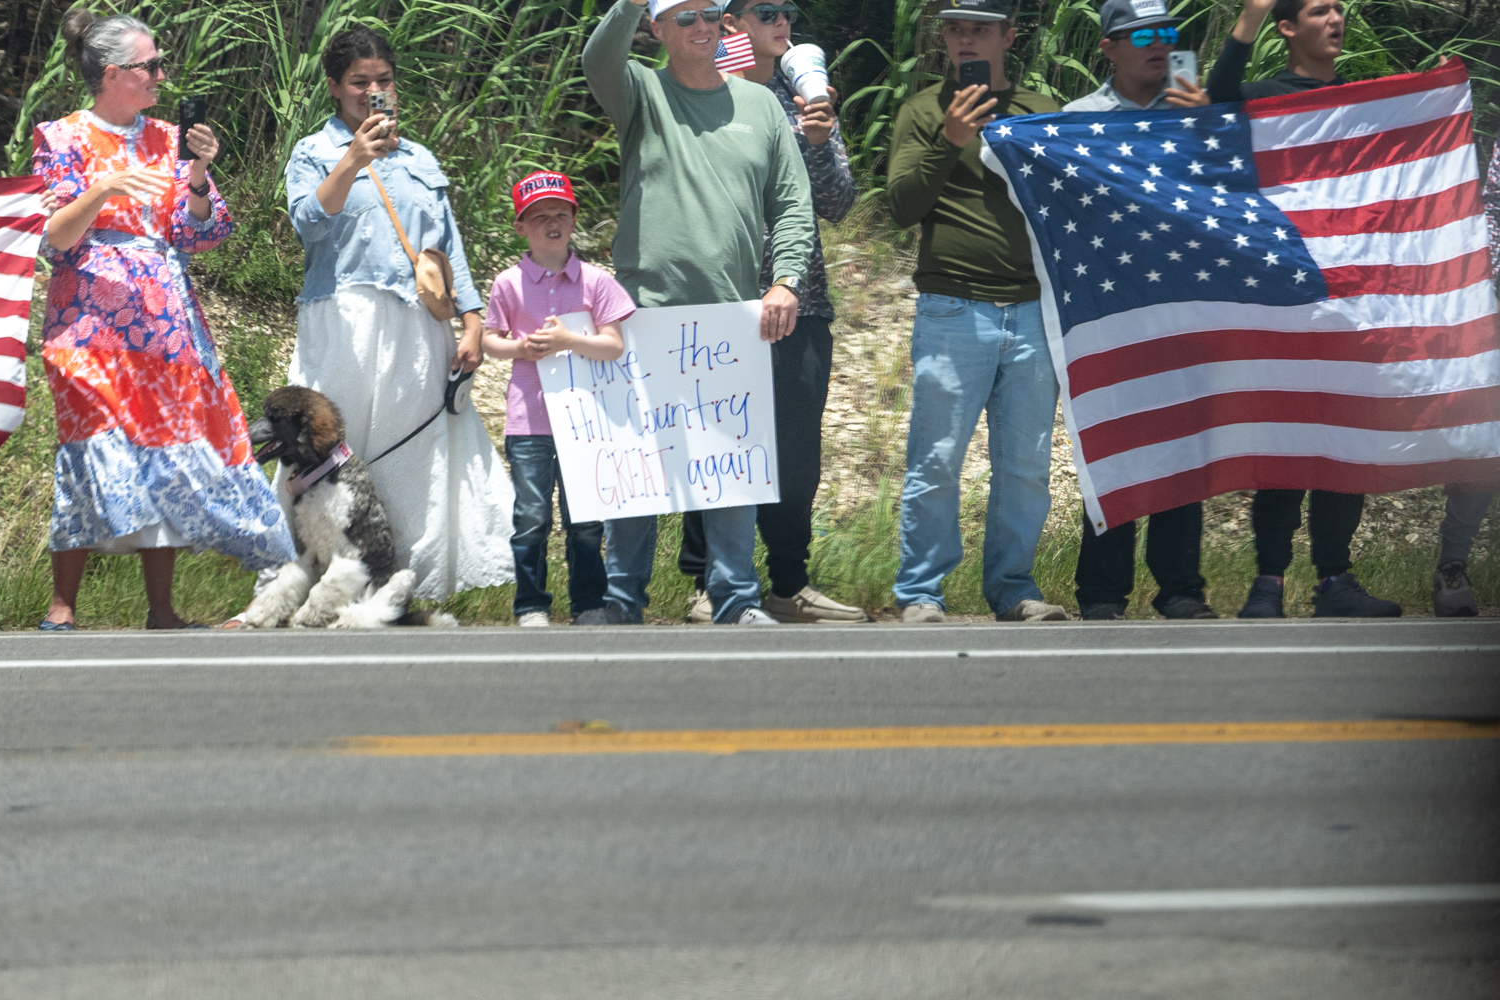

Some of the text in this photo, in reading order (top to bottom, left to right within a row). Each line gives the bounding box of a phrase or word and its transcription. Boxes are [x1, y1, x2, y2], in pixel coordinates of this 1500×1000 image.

[518, 178, 566, 197] TRUMP
[669, 321, 739, 375] the
[565, 390, 613, 443] Hill
[595, 444, 771, 510] GREAT again
